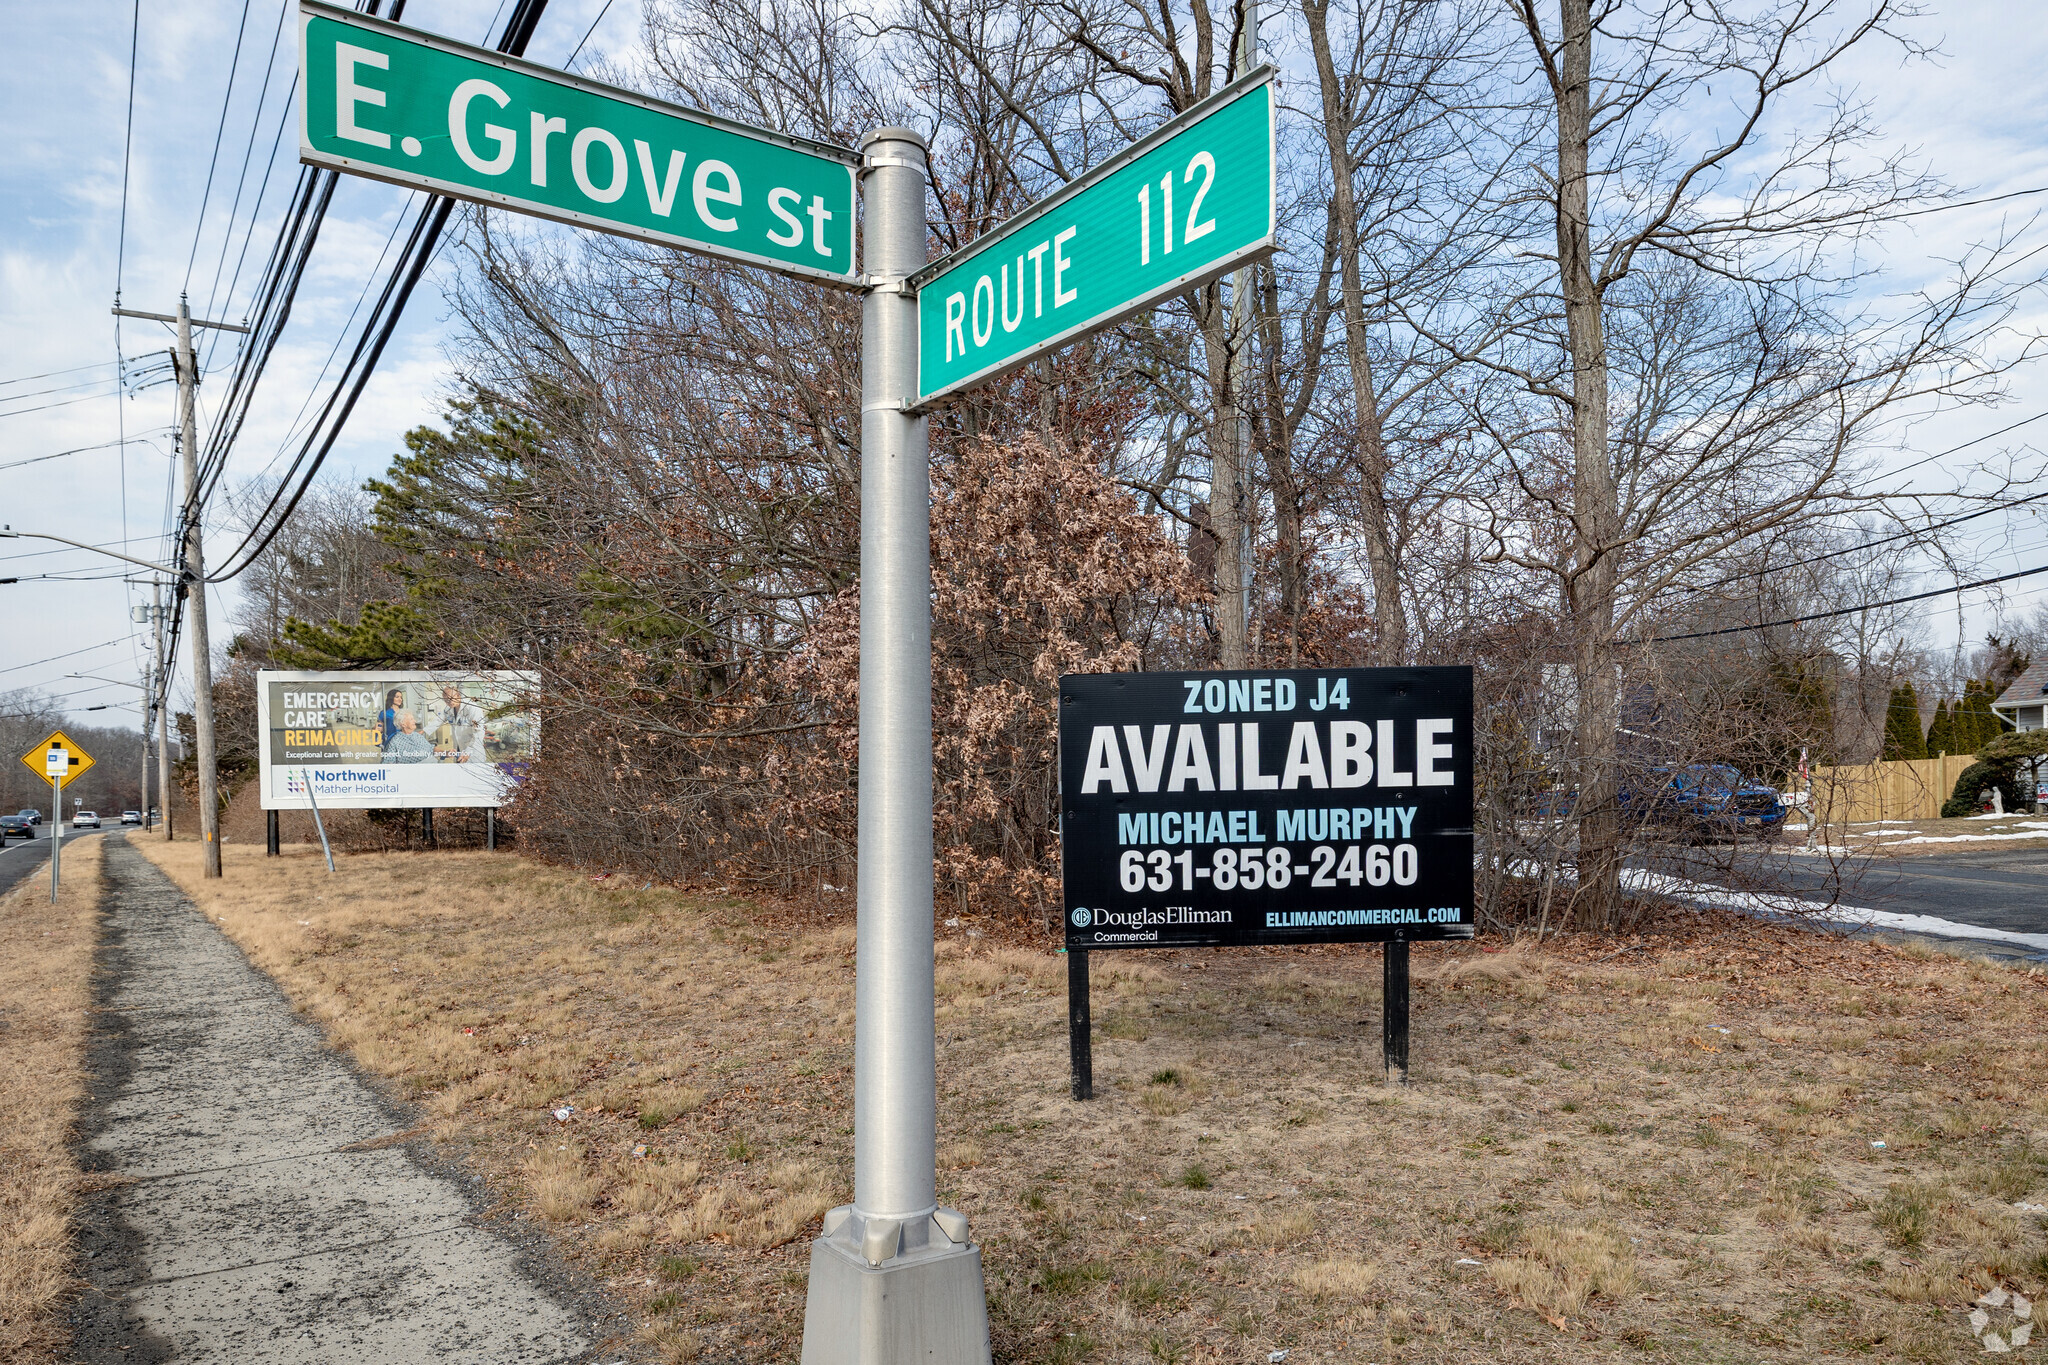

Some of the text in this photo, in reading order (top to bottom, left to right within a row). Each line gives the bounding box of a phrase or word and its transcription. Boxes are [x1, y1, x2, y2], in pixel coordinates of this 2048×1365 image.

[335, 41, 422, 157] E.
[448, 78, 743, 233] Grove
[946, 150, 1217, 363] ROUTE 112
[283, 691, 382, 709] EMERGENCY
[1183, 678, 1351, 713] ZONED J4
[284, 711, 328, 728] CARE
[284, 729, 383, 747] REIMAGINED
[285, 751, 323, 760] Exceptional
[340, 751, 354, 759] with
[354, 751, 379, 760] greater
[434, 750, 447, 758] and
[1081, 718, 1455, 794] AVAILABLE
[315, 769, 386, 781] Northwell
[315, 784, 400, 795] Mather Hospital
[1118, 806, 1418, 845] MICHAEL MURPHY
[1119, 843, 1418, 893] 631-858-2460
[1265, 907, 1461, 927] ELLIMANCOMMERCIAL.COM
[1094, 930, 1158, 942] Commercial
